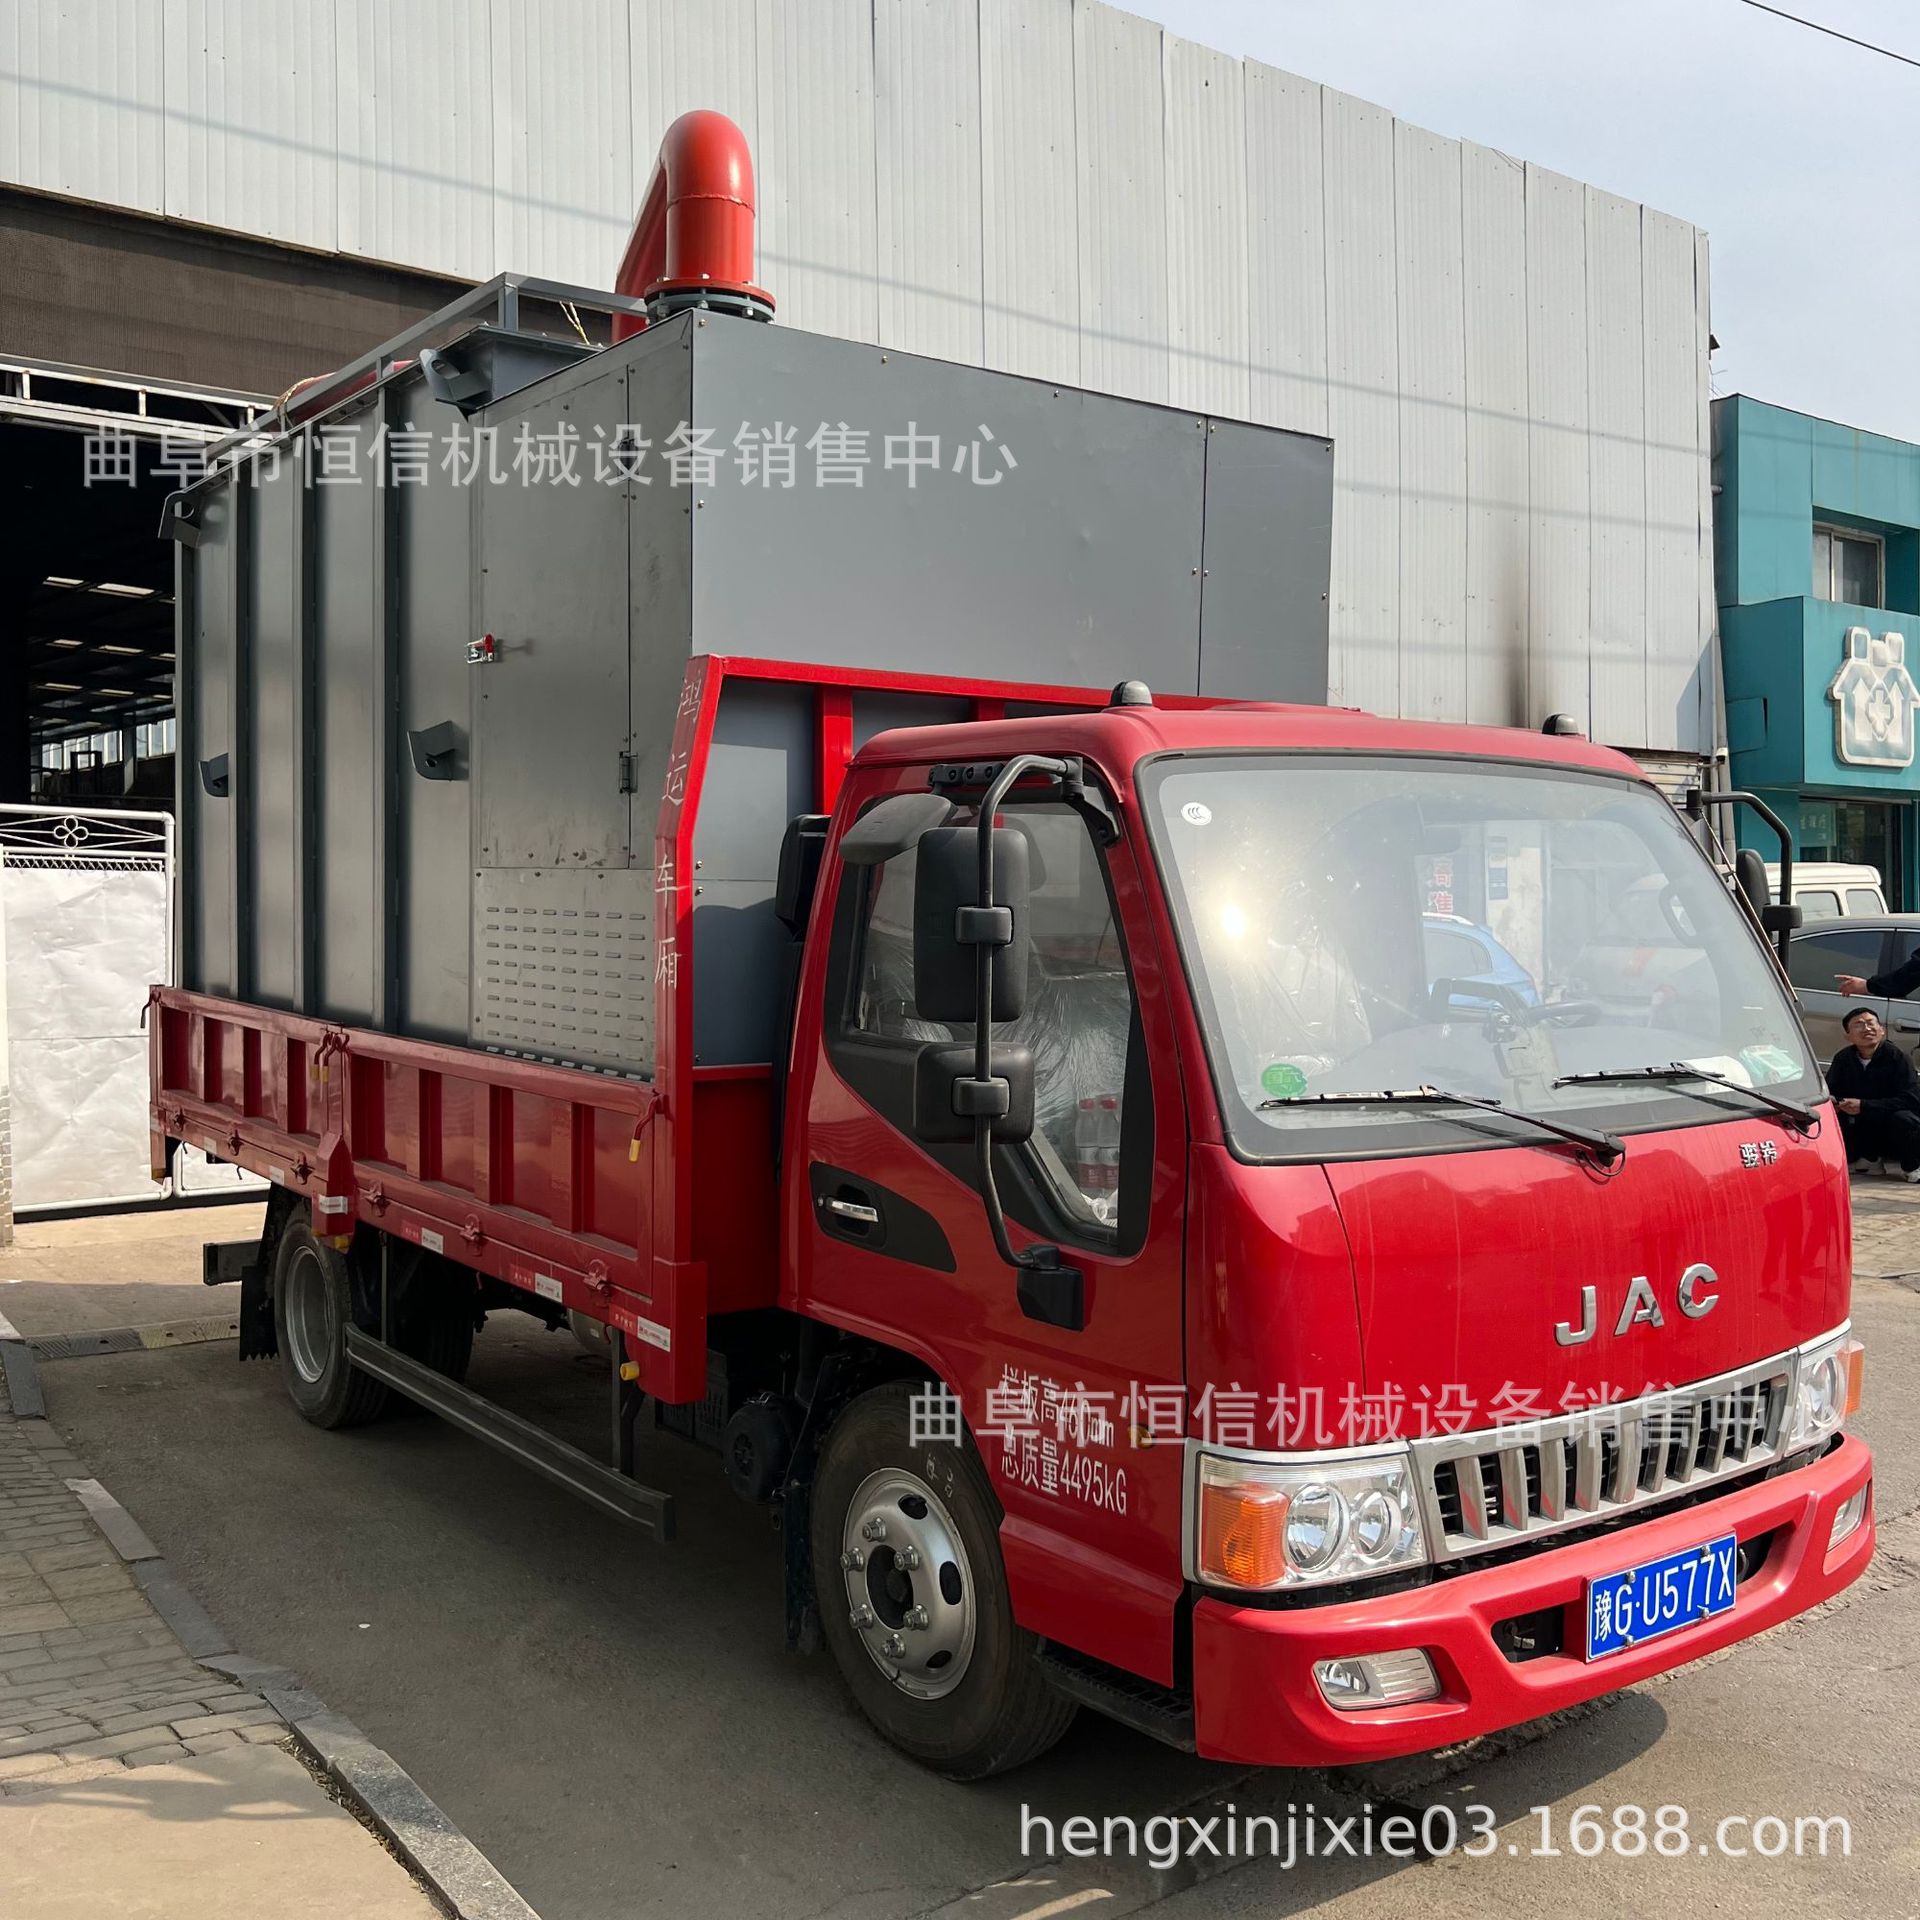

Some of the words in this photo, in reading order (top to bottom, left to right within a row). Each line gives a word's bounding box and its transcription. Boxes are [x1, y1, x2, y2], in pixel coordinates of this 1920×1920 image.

[655, 678, 701, 991] 鸿运车厢
[1556, 1263, 1719, 1346] JAC
